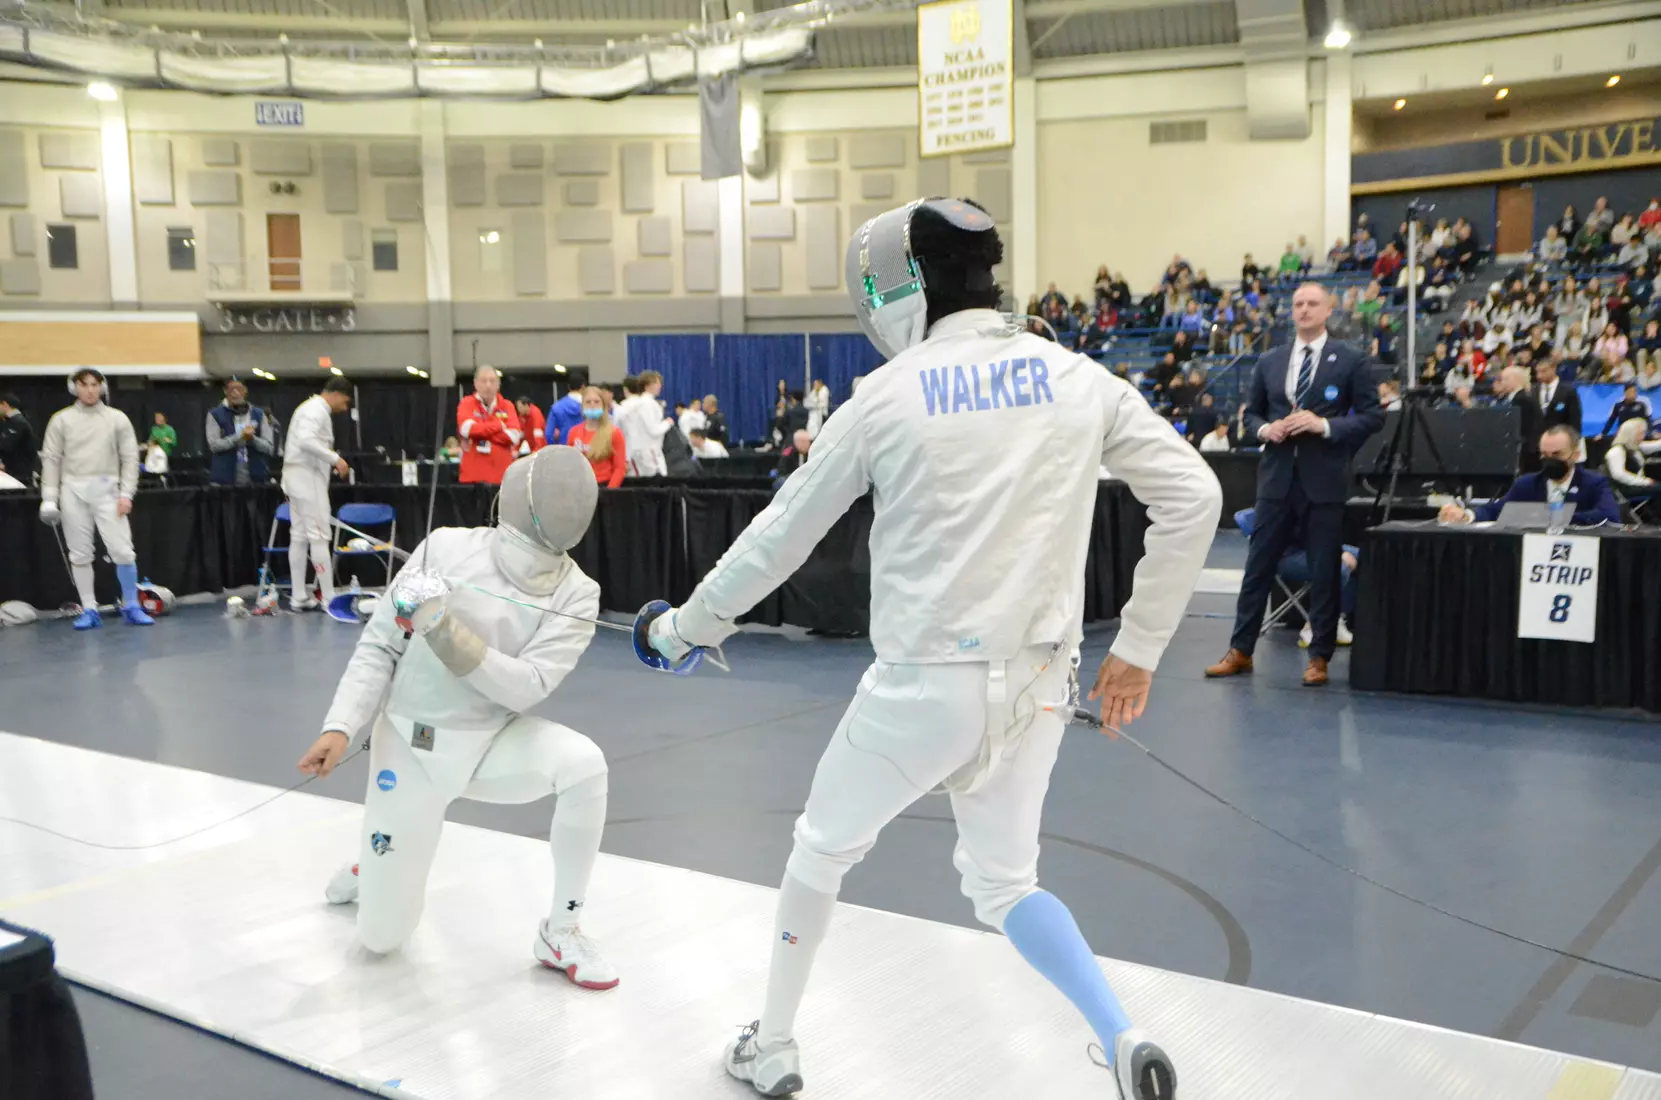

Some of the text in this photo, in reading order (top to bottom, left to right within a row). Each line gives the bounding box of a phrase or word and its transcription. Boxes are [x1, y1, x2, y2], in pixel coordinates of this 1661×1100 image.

[944, 47, 984, 66] NCAA
[924, 62, 1005, 88] CHAMPION
[264, 102, 294, 125] EXIT
[936, 127, 995, 147] FENCING
[1502, 119, 1656, 169] UNIVE
[252, 308, 323, 332] GATE
[919, 357, 1054, 416] WALKER
[1529, 564, 1593, 586] STRIP
[1549, 594, 1573, 623] 8
